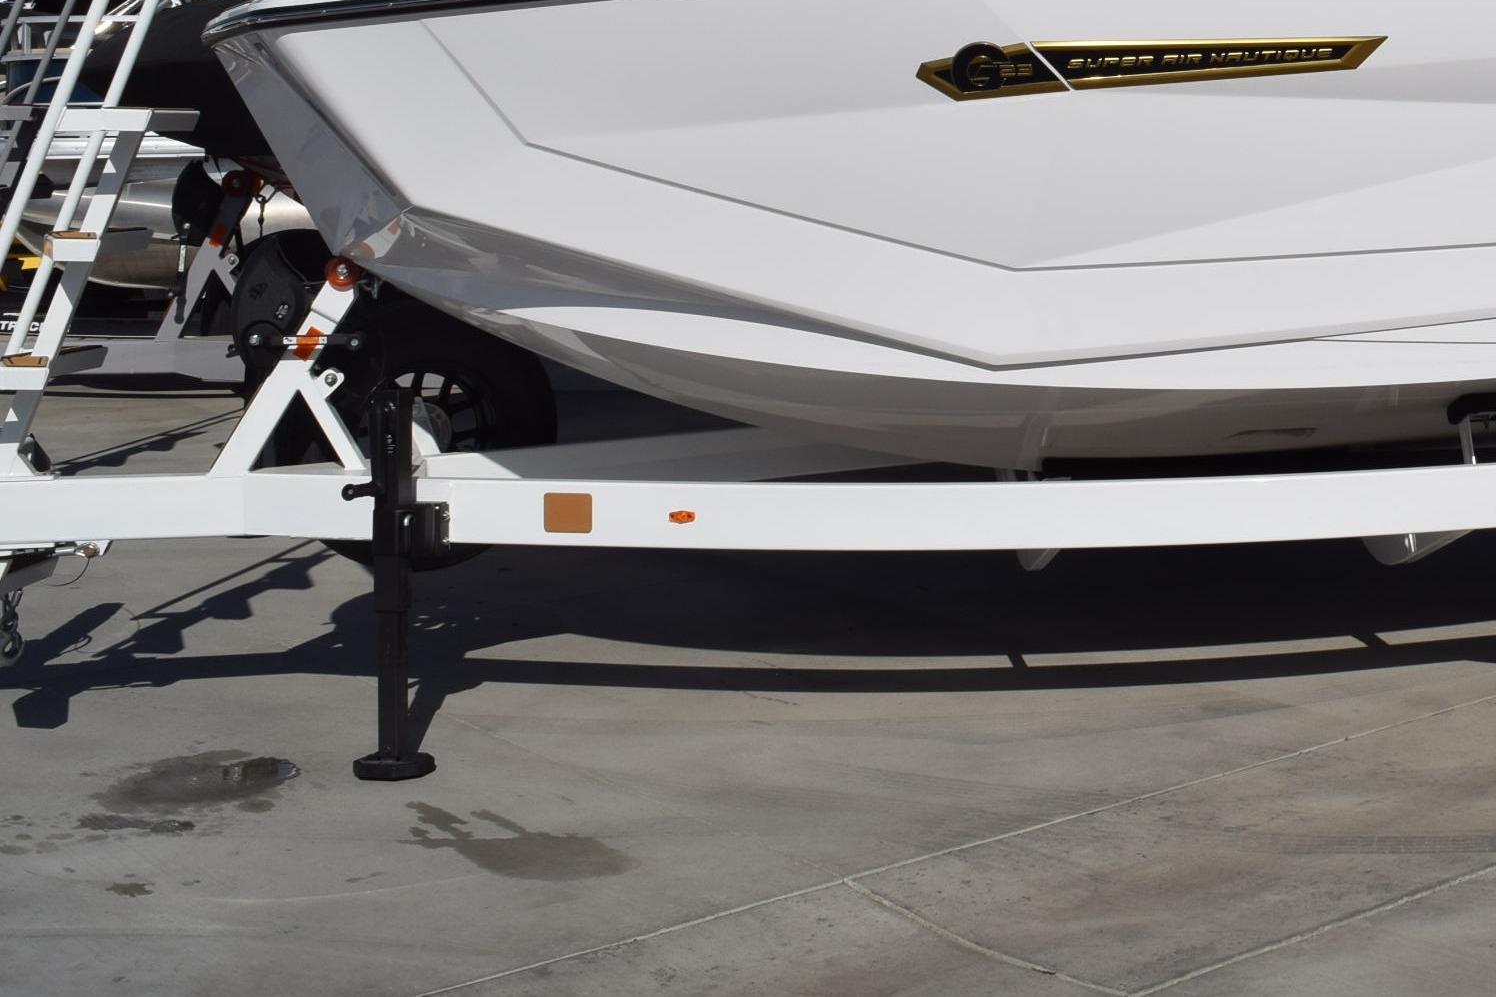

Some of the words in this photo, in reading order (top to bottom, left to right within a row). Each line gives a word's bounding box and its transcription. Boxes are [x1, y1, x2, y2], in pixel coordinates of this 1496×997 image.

[1067, 55, 1154, 69] SUPER
[1161, 53, 1203, 66] AIR
[1210, 48, 1334, 63] NAUTIQUE
